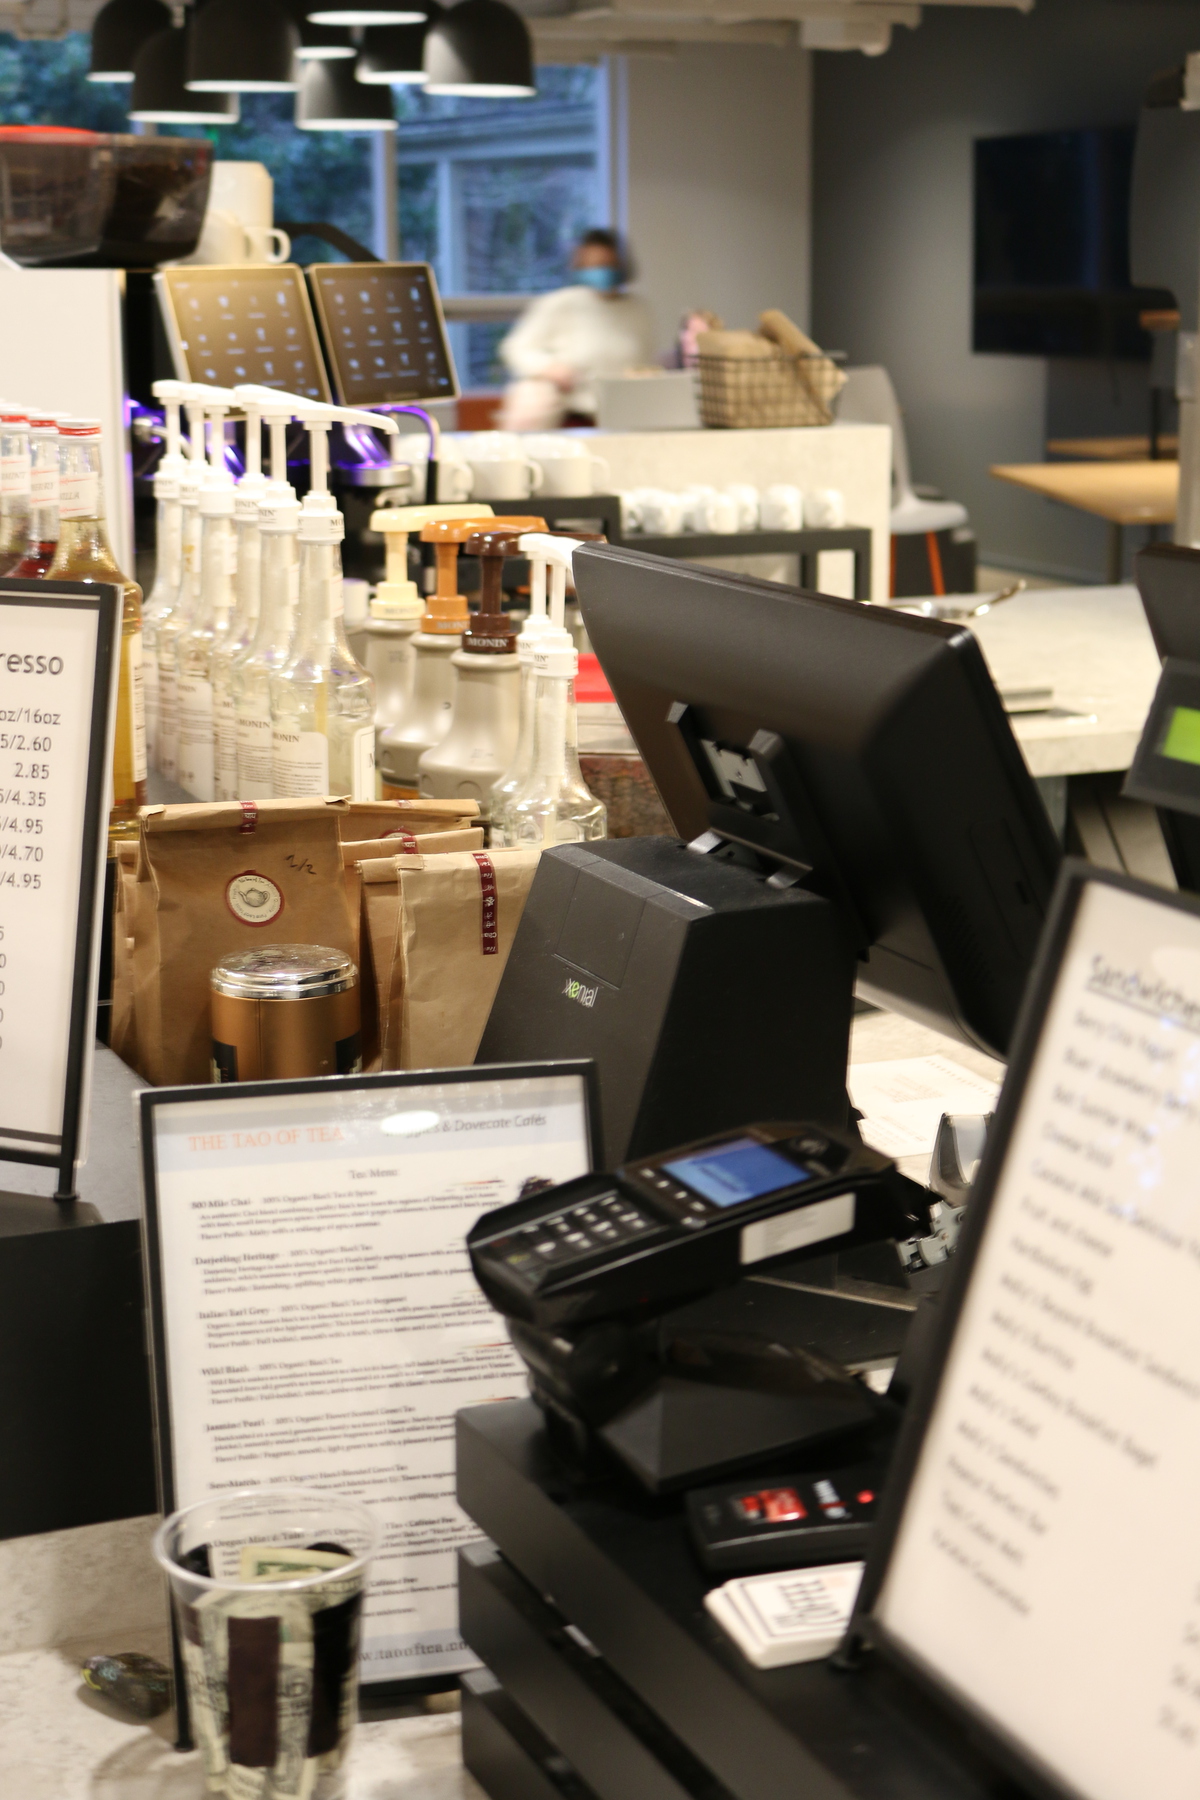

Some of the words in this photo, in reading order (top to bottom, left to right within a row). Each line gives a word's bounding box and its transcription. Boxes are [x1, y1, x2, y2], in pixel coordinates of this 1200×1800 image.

[468, 637, 508, 648] MONIN
[15, 761, 49, 780] 2.85
[0, 816, 43, 835] /4.95
[0, 844, 43, 863] /4.70
[189, 1133, 225, 1151] THE
[232, 1131, 271, 1148] TAO
[276, 1128, 301, 1145] OF
[306, 1126, 344, 1142] TEA
